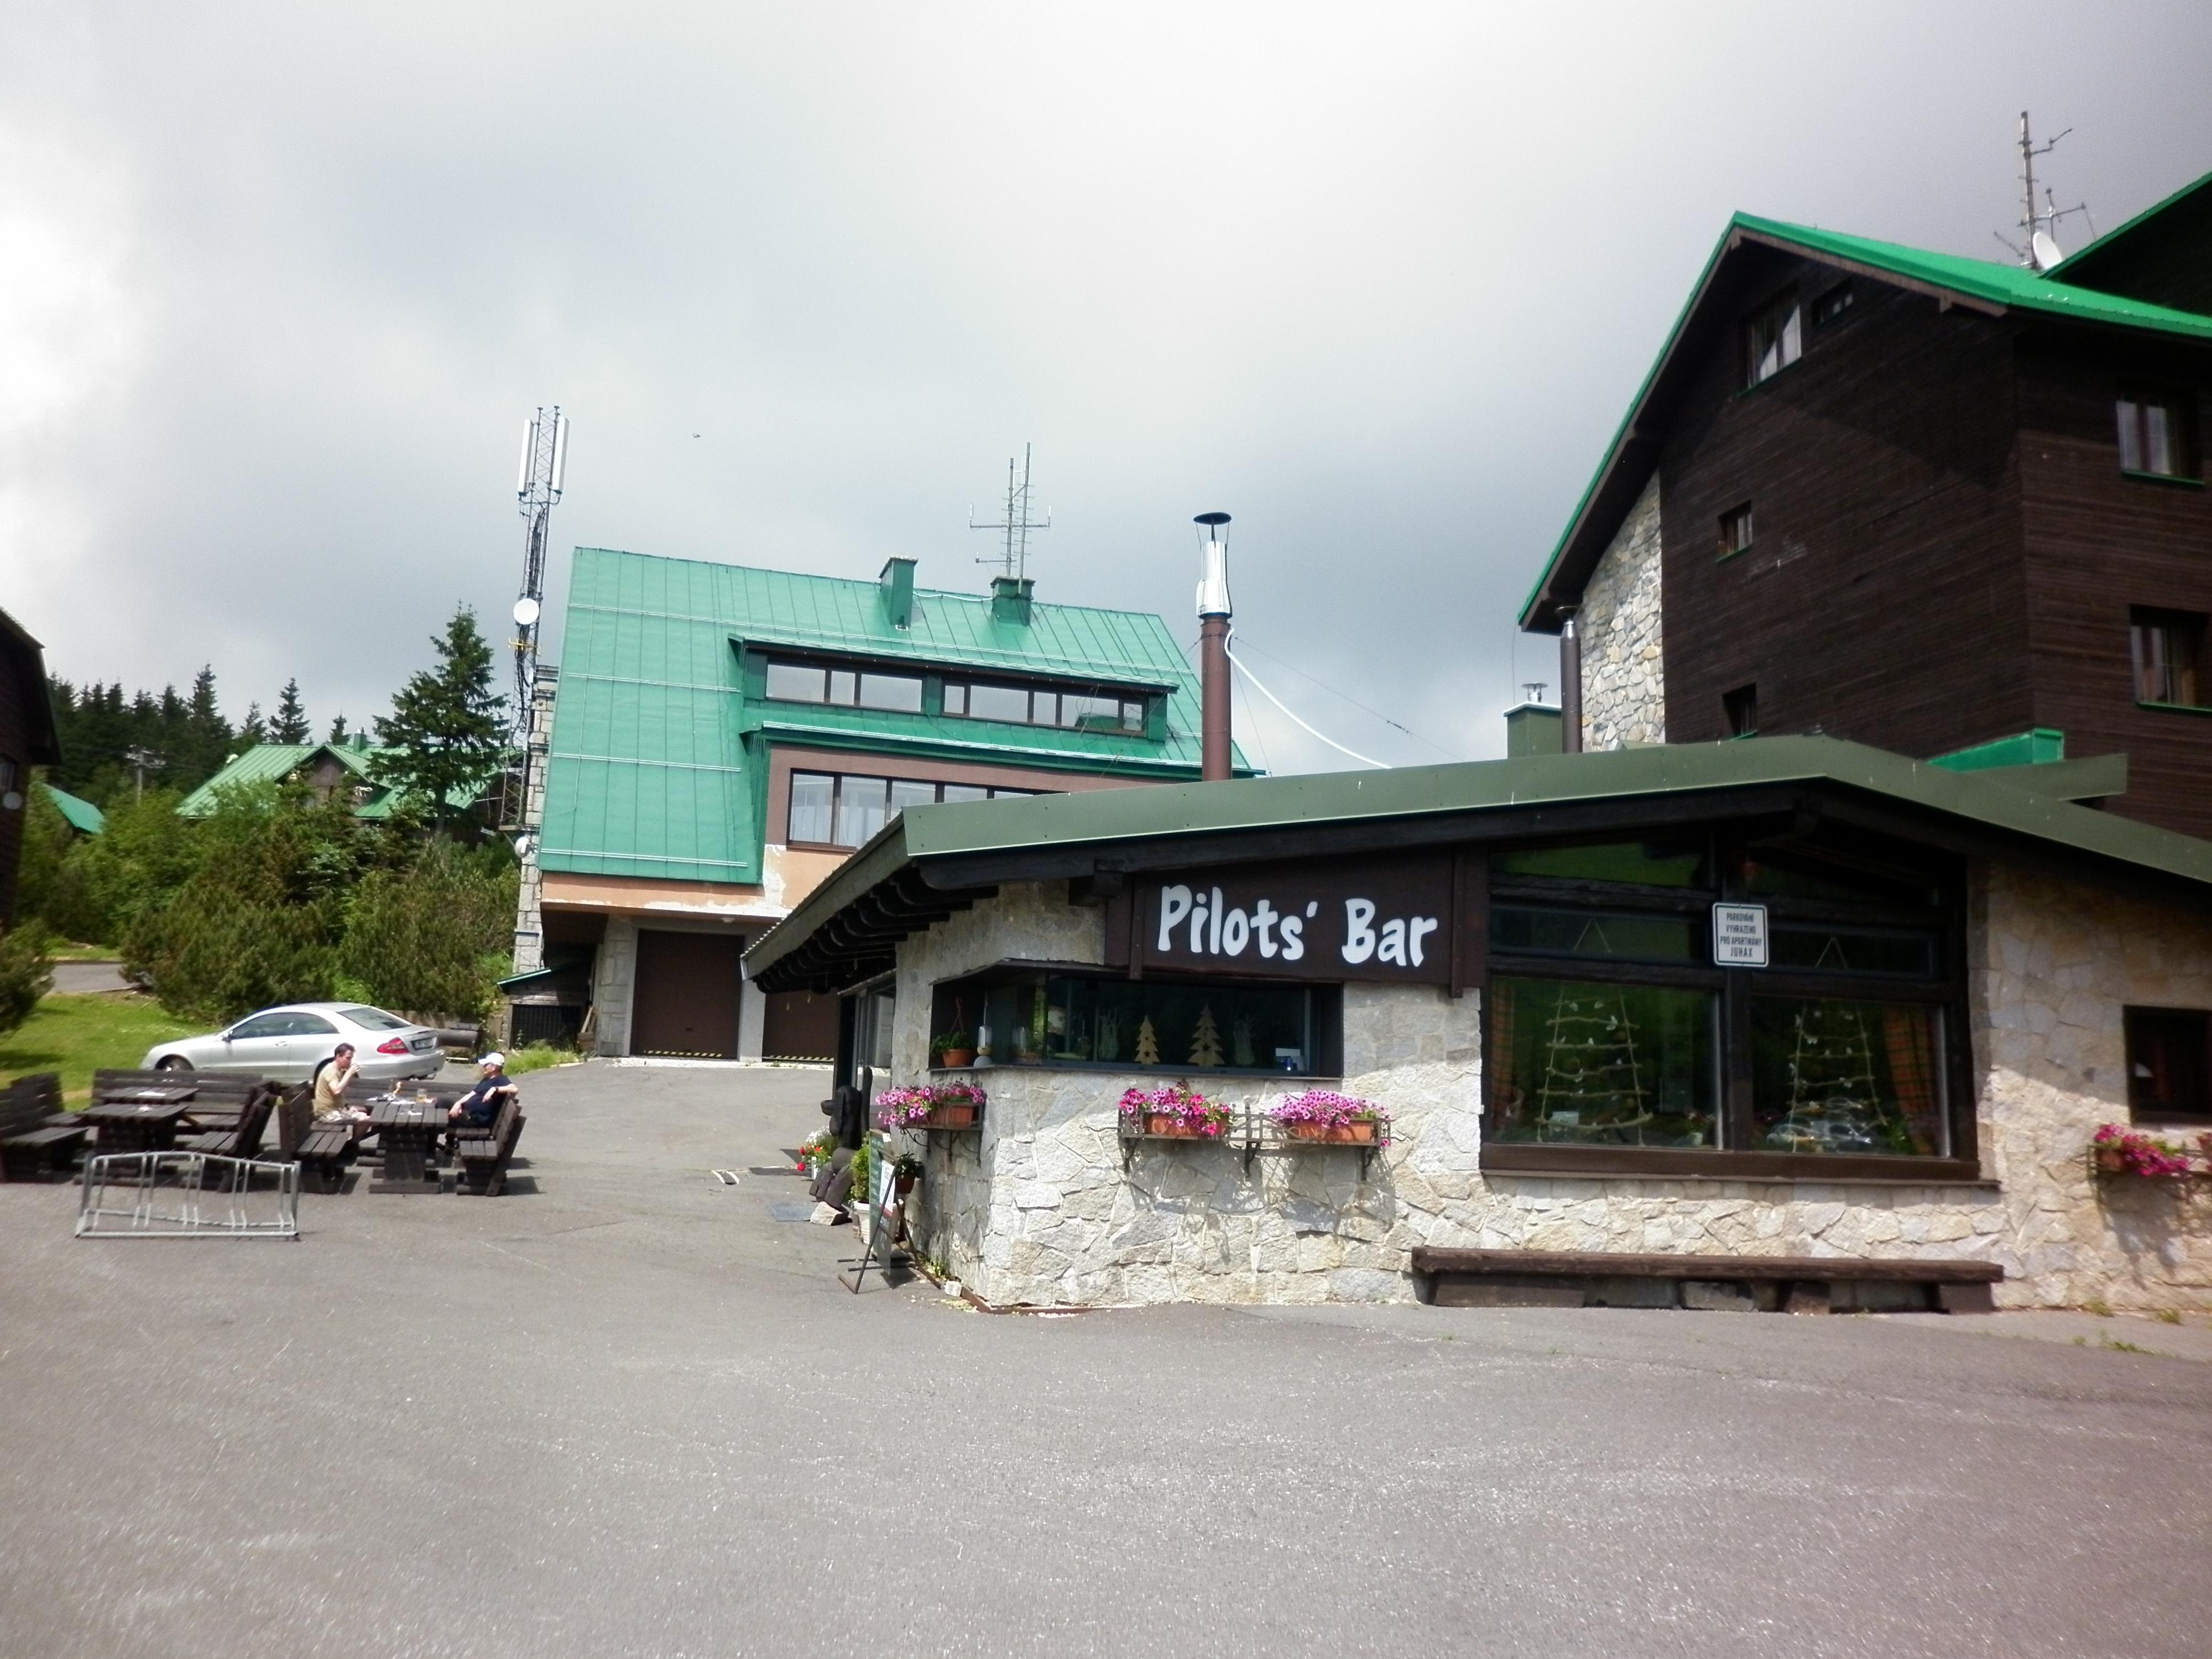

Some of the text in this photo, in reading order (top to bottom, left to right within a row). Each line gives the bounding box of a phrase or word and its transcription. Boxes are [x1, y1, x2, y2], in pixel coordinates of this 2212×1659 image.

[1157, 885, 1438, 967] Pilots' Bar
[1720, 936, 1730, 945] PRO
[1730, 947, 1752, 957] JUHAX
